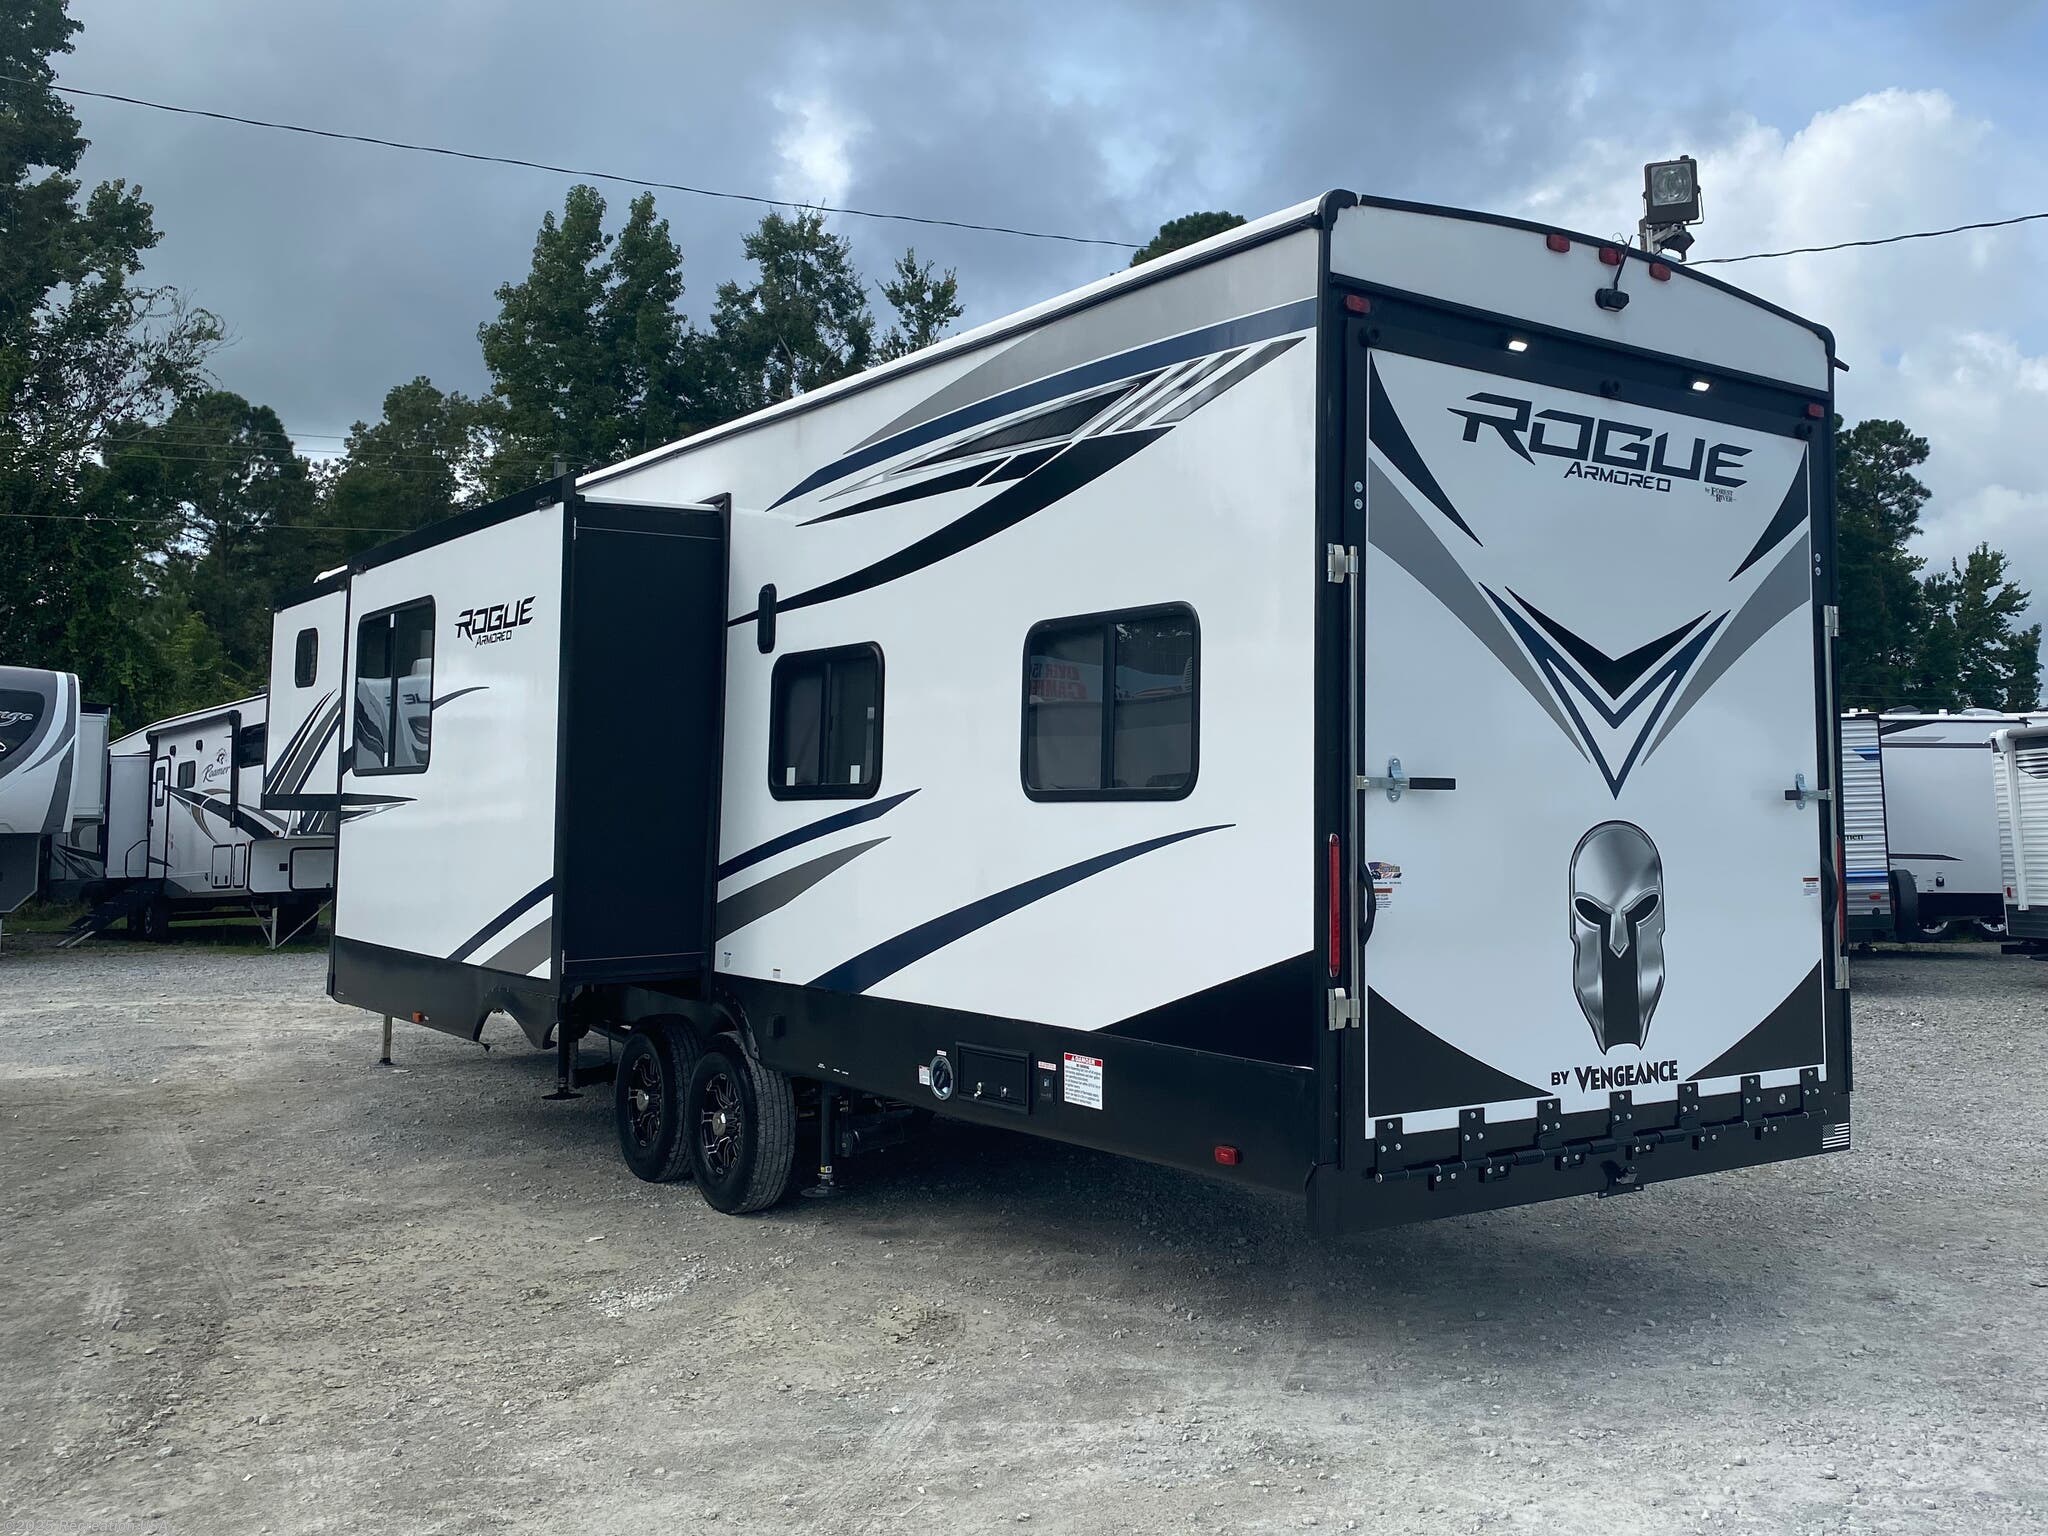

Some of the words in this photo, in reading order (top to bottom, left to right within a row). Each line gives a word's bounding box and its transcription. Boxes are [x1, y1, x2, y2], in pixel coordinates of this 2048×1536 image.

[1447, 392, 1753, 488] ROGUE
[1564, 461, 1672, 492] ARMORED
[454, 596, 537, 642] ROGUE
[475, 630, 513, 649] ARMORED
[1551, 1070, 1570, 1086] BY
[1574, 1060, 1678, 1093] VENGEANCE
